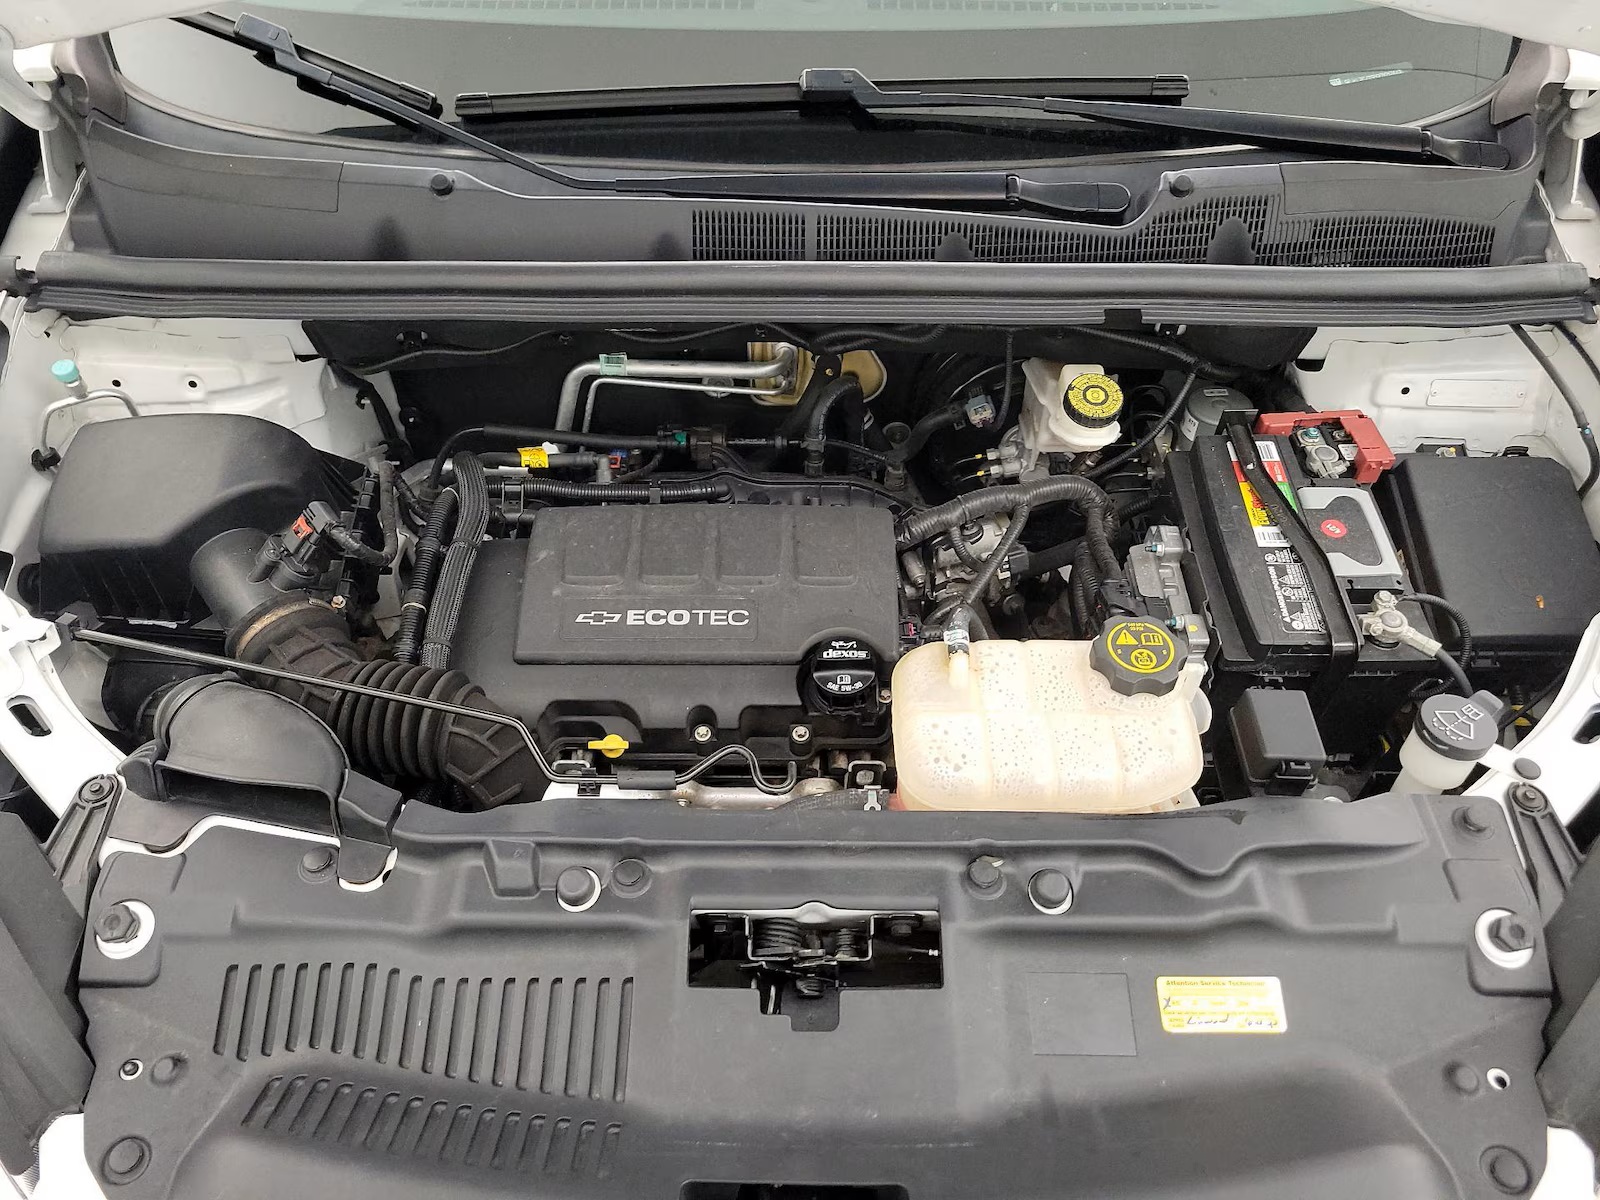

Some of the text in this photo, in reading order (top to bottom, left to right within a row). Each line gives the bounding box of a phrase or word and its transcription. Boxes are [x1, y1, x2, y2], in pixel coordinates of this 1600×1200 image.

[626, 609, 750, 626] ECOTEC
[822, 648, 868, 659] dexos
[826, 682, 840, 691] SAE
